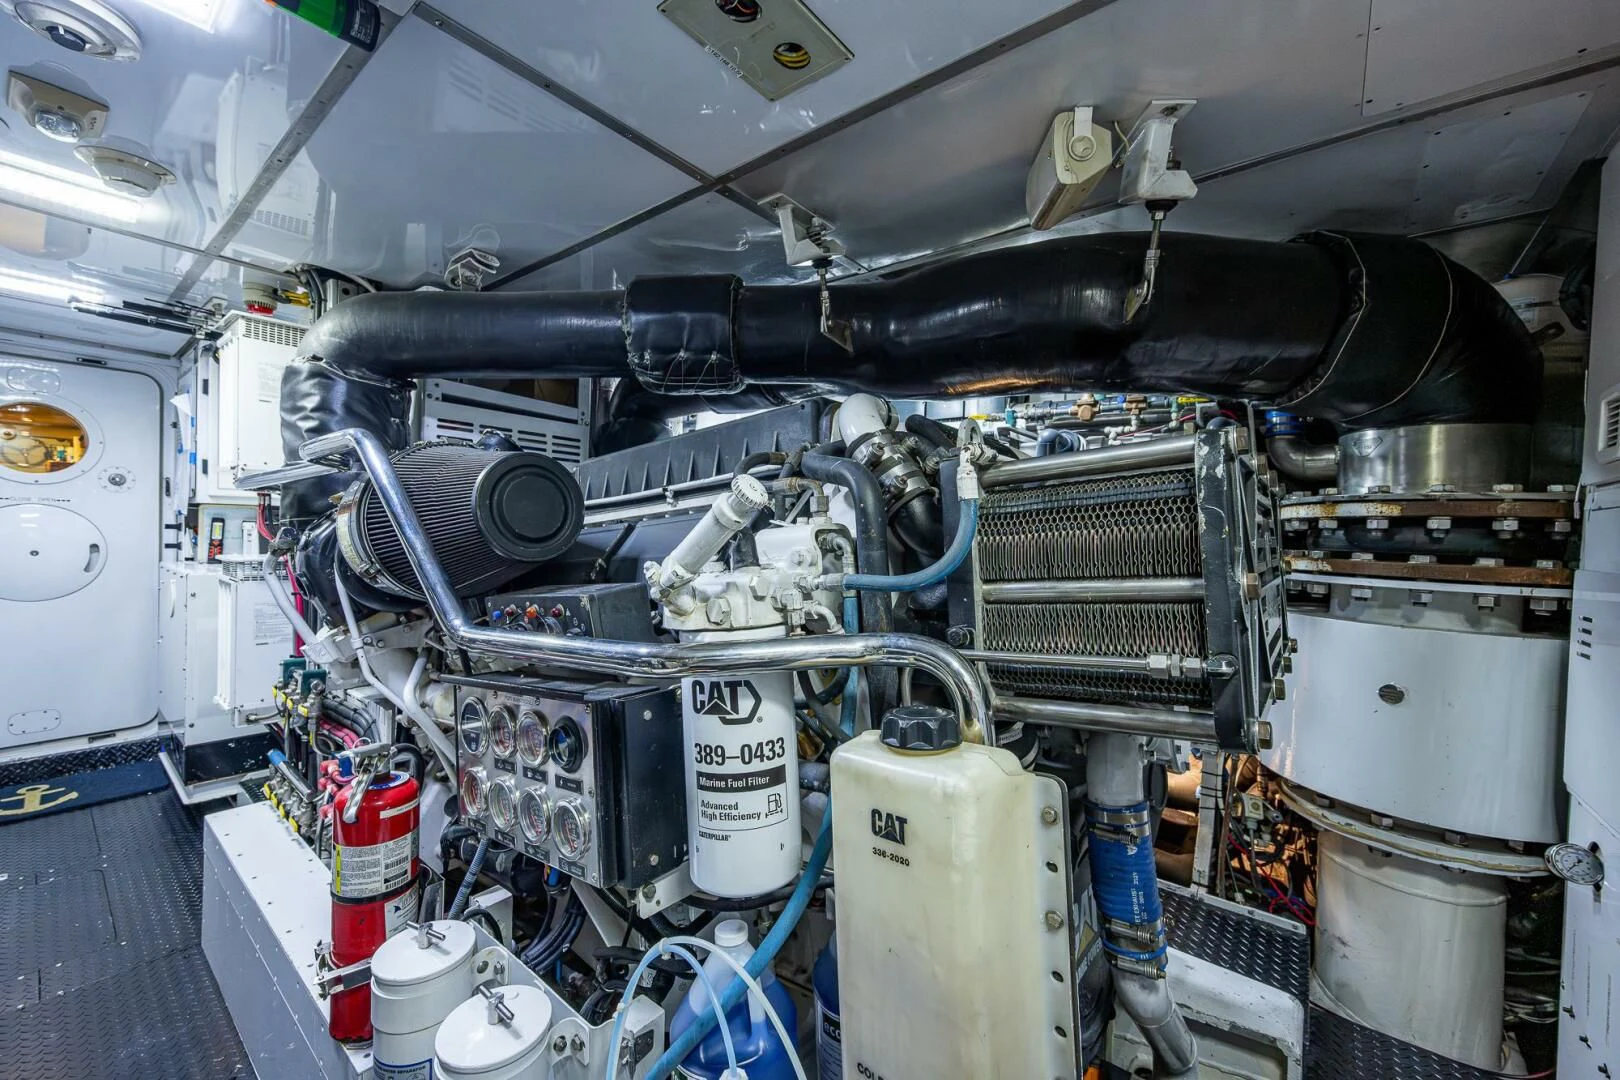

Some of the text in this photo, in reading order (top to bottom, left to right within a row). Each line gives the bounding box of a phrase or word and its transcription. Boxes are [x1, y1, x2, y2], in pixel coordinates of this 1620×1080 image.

[692, 679, 743, 715] CAT
[694, 736, 786, 766] 389-0433
[699, 776, 770, 788] Marine Fuel Filter
[700, 799, 739, 811] Advanced
[701, 809, 762, 822] High Efficiency
[871, 808, 908, 846] CAT
[872, 846, 910, 867] 336-2020
